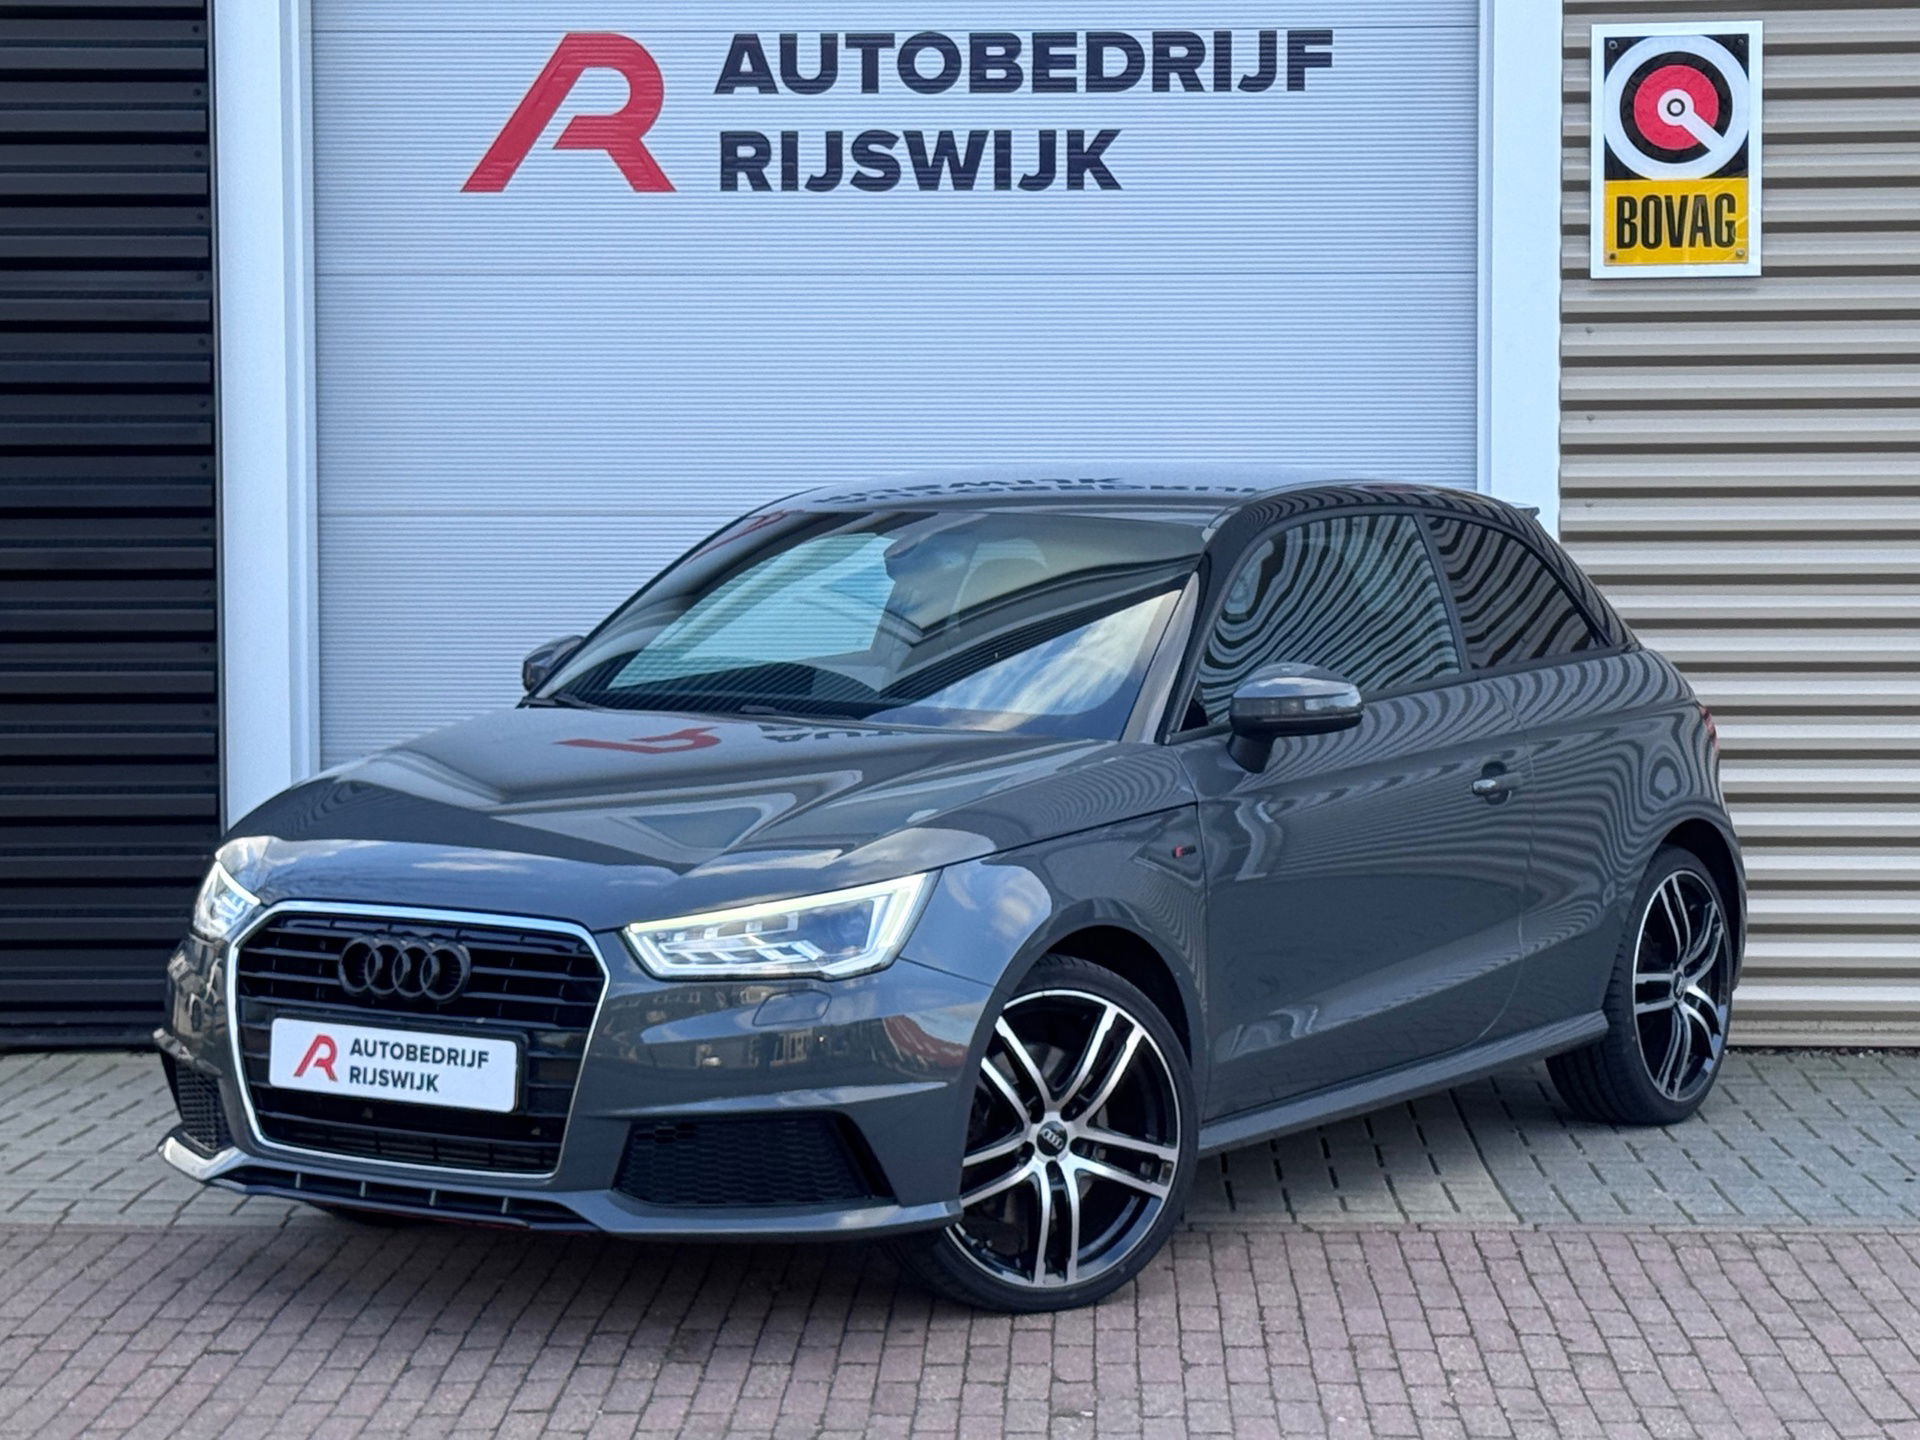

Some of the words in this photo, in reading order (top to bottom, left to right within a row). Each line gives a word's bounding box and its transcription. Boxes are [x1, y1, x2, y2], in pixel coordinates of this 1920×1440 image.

[714, 30, 1333, 93] AUTOBEDRIJF
[719, 130, 1122, 192] RIJSWIJK
[1616, 194, 1736, 249] BOVAG
[350, 1039, 489, 1069] AUTOBEDRIJF
[350, 1067, 438, 1092] RIJSWIJK
